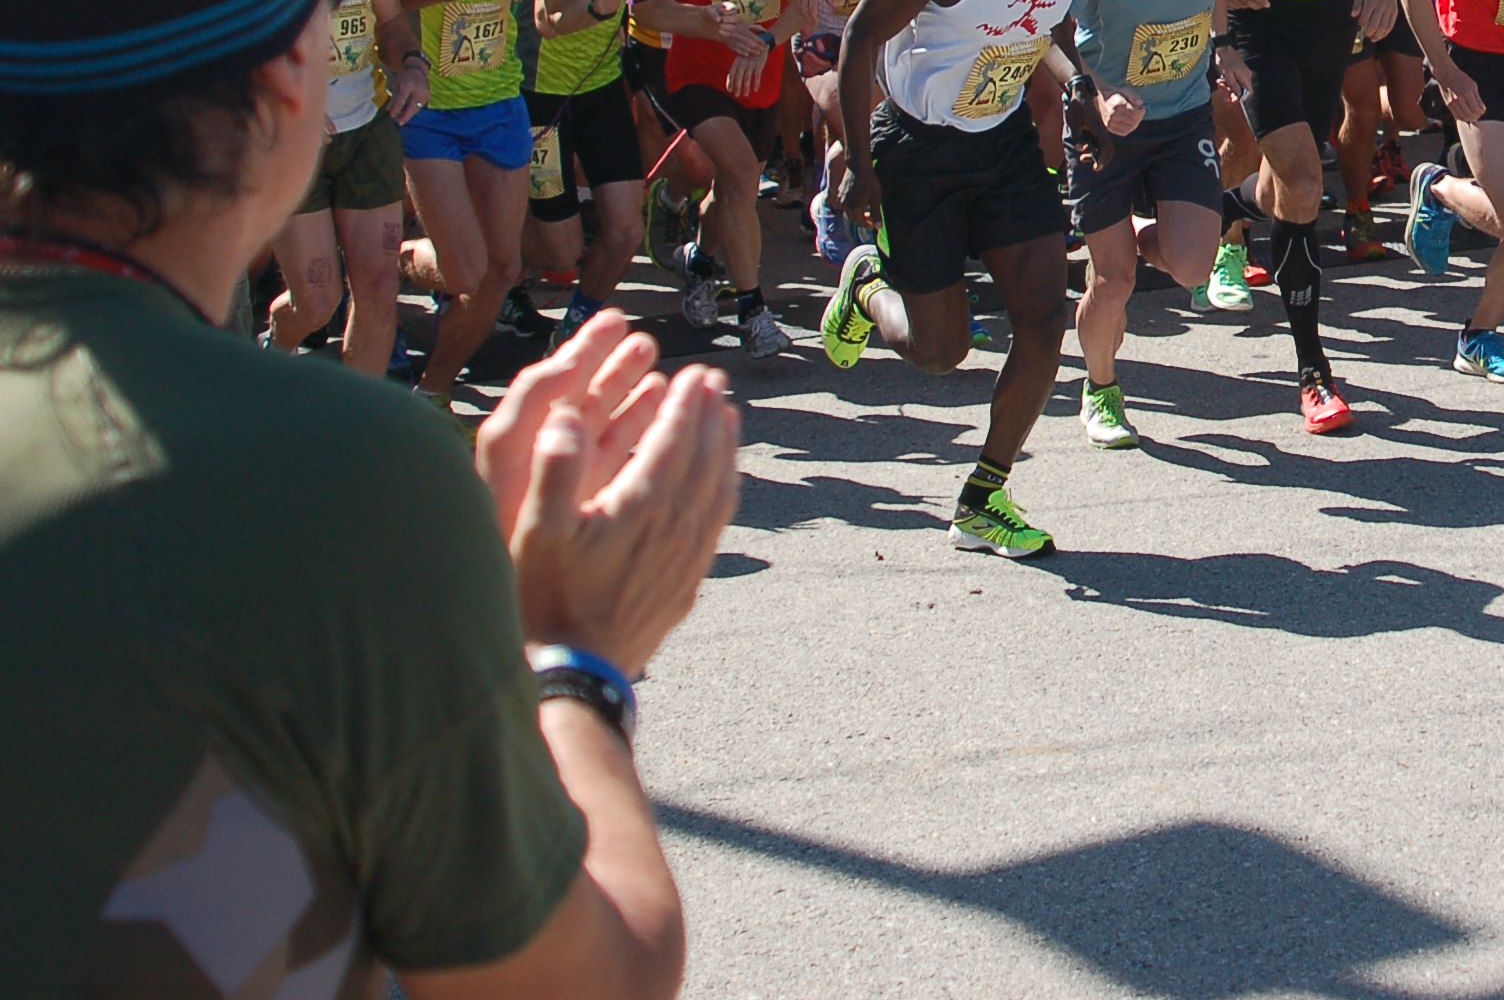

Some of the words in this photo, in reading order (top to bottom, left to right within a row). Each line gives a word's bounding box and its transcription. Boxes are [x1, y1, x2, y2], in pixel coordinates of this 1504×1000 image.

[340, 15, 367, 37] 965
[473, 18, 504, 40] 1671
[1169, 34, 1200, 54] 230
